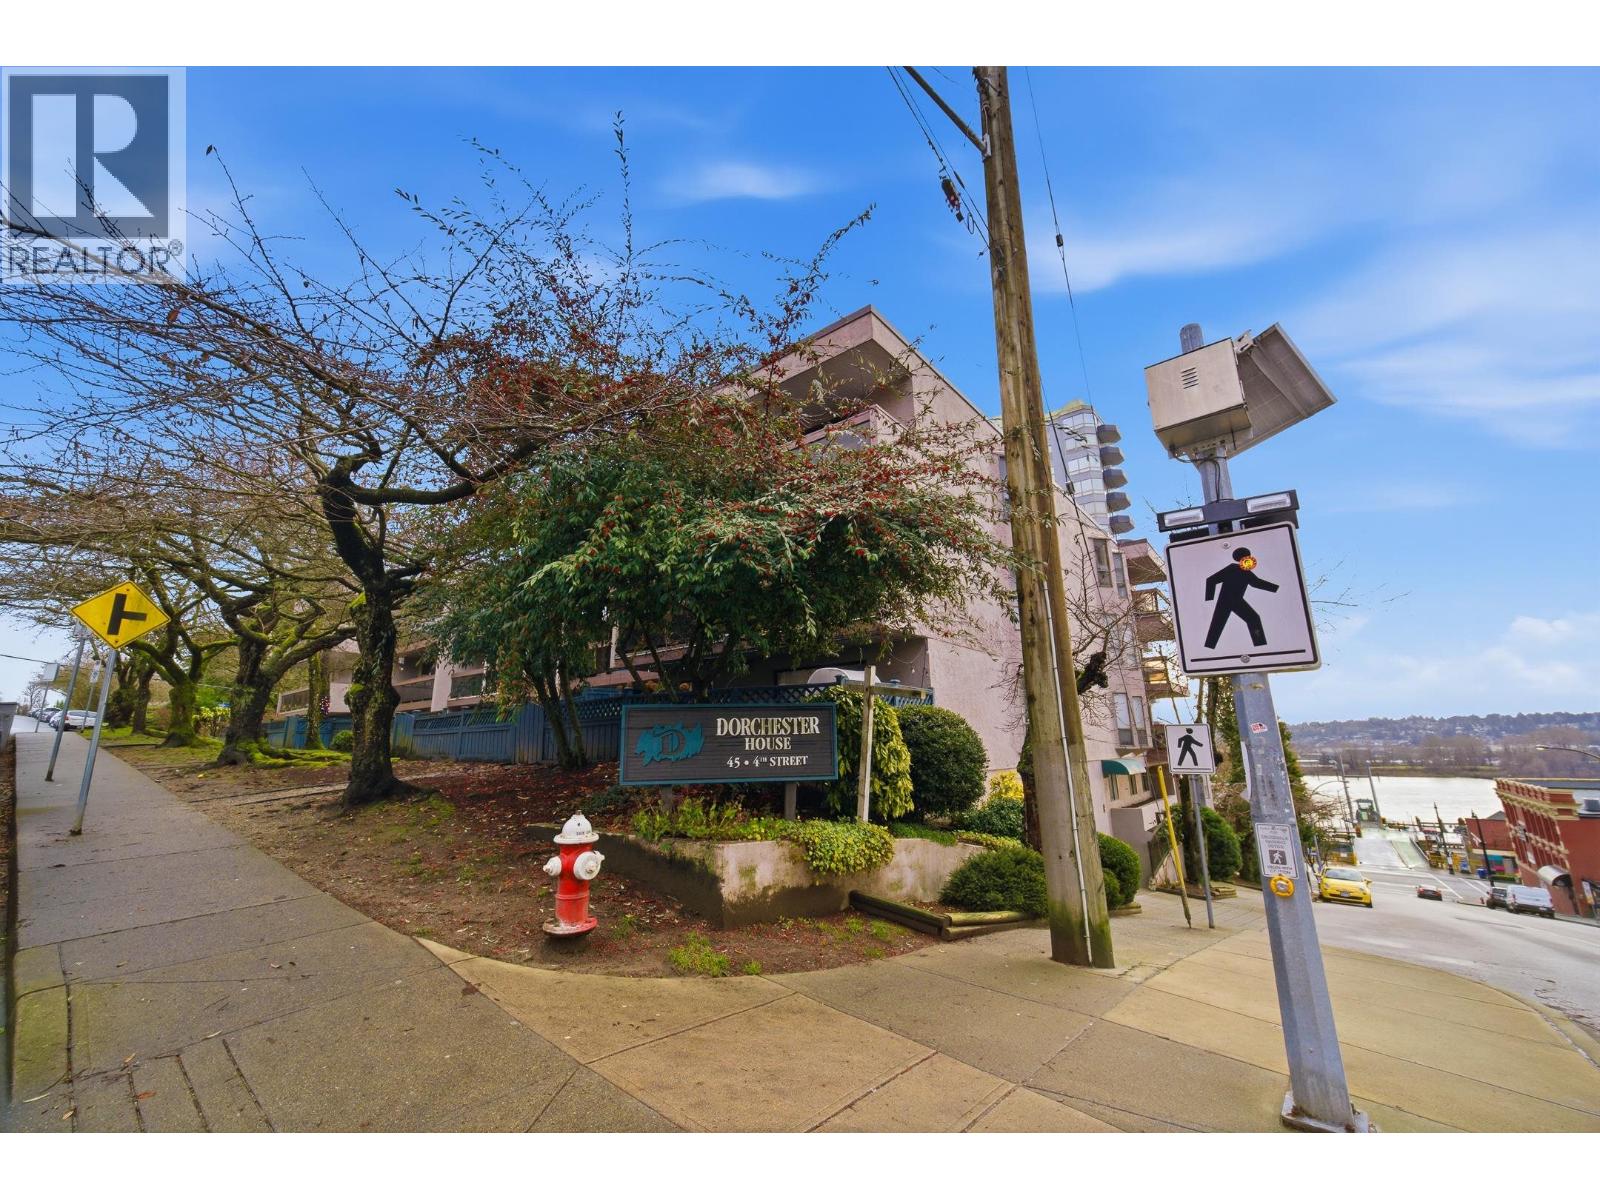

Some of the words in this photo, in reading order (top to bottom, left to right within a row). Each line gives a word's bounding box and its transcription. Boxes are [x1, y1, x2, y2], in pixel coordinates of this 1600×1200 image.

[716, 716, 820, 736] DORCHESTER
[744, 737, 792, 750] HOUSE
[727, 756, 741, 768] 45
[769, 755, 809, 767] STREET
